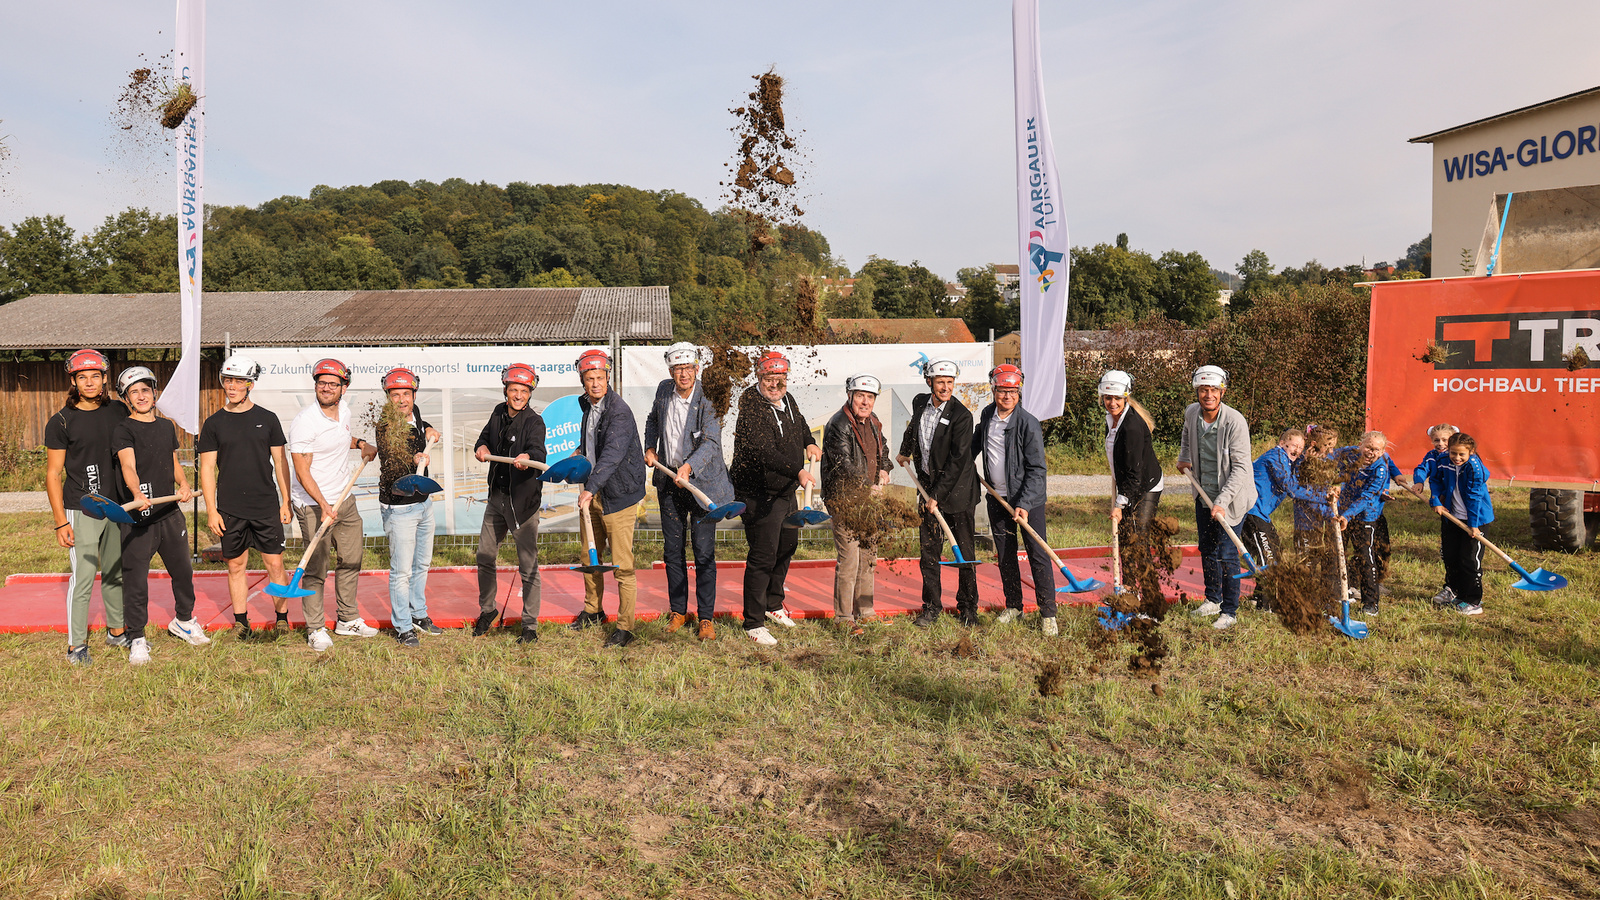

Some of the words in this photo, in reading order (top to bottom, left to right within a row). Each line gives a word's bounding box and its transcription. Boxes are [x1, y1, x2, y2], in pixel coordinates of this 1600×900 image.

[1443, 124, 1600, 182] WISA-GLOR
[1027, 116, 1045, 229] AARGAUER
[270, 363, 312, 375] Zukunft
[1433, 377, 1547, 393] HOCHBAU.
[1554, 377, 1600, 393] TIEF
[546, 421, 582, 439] Eröffn
[546, 439, 576, 456] Ende
